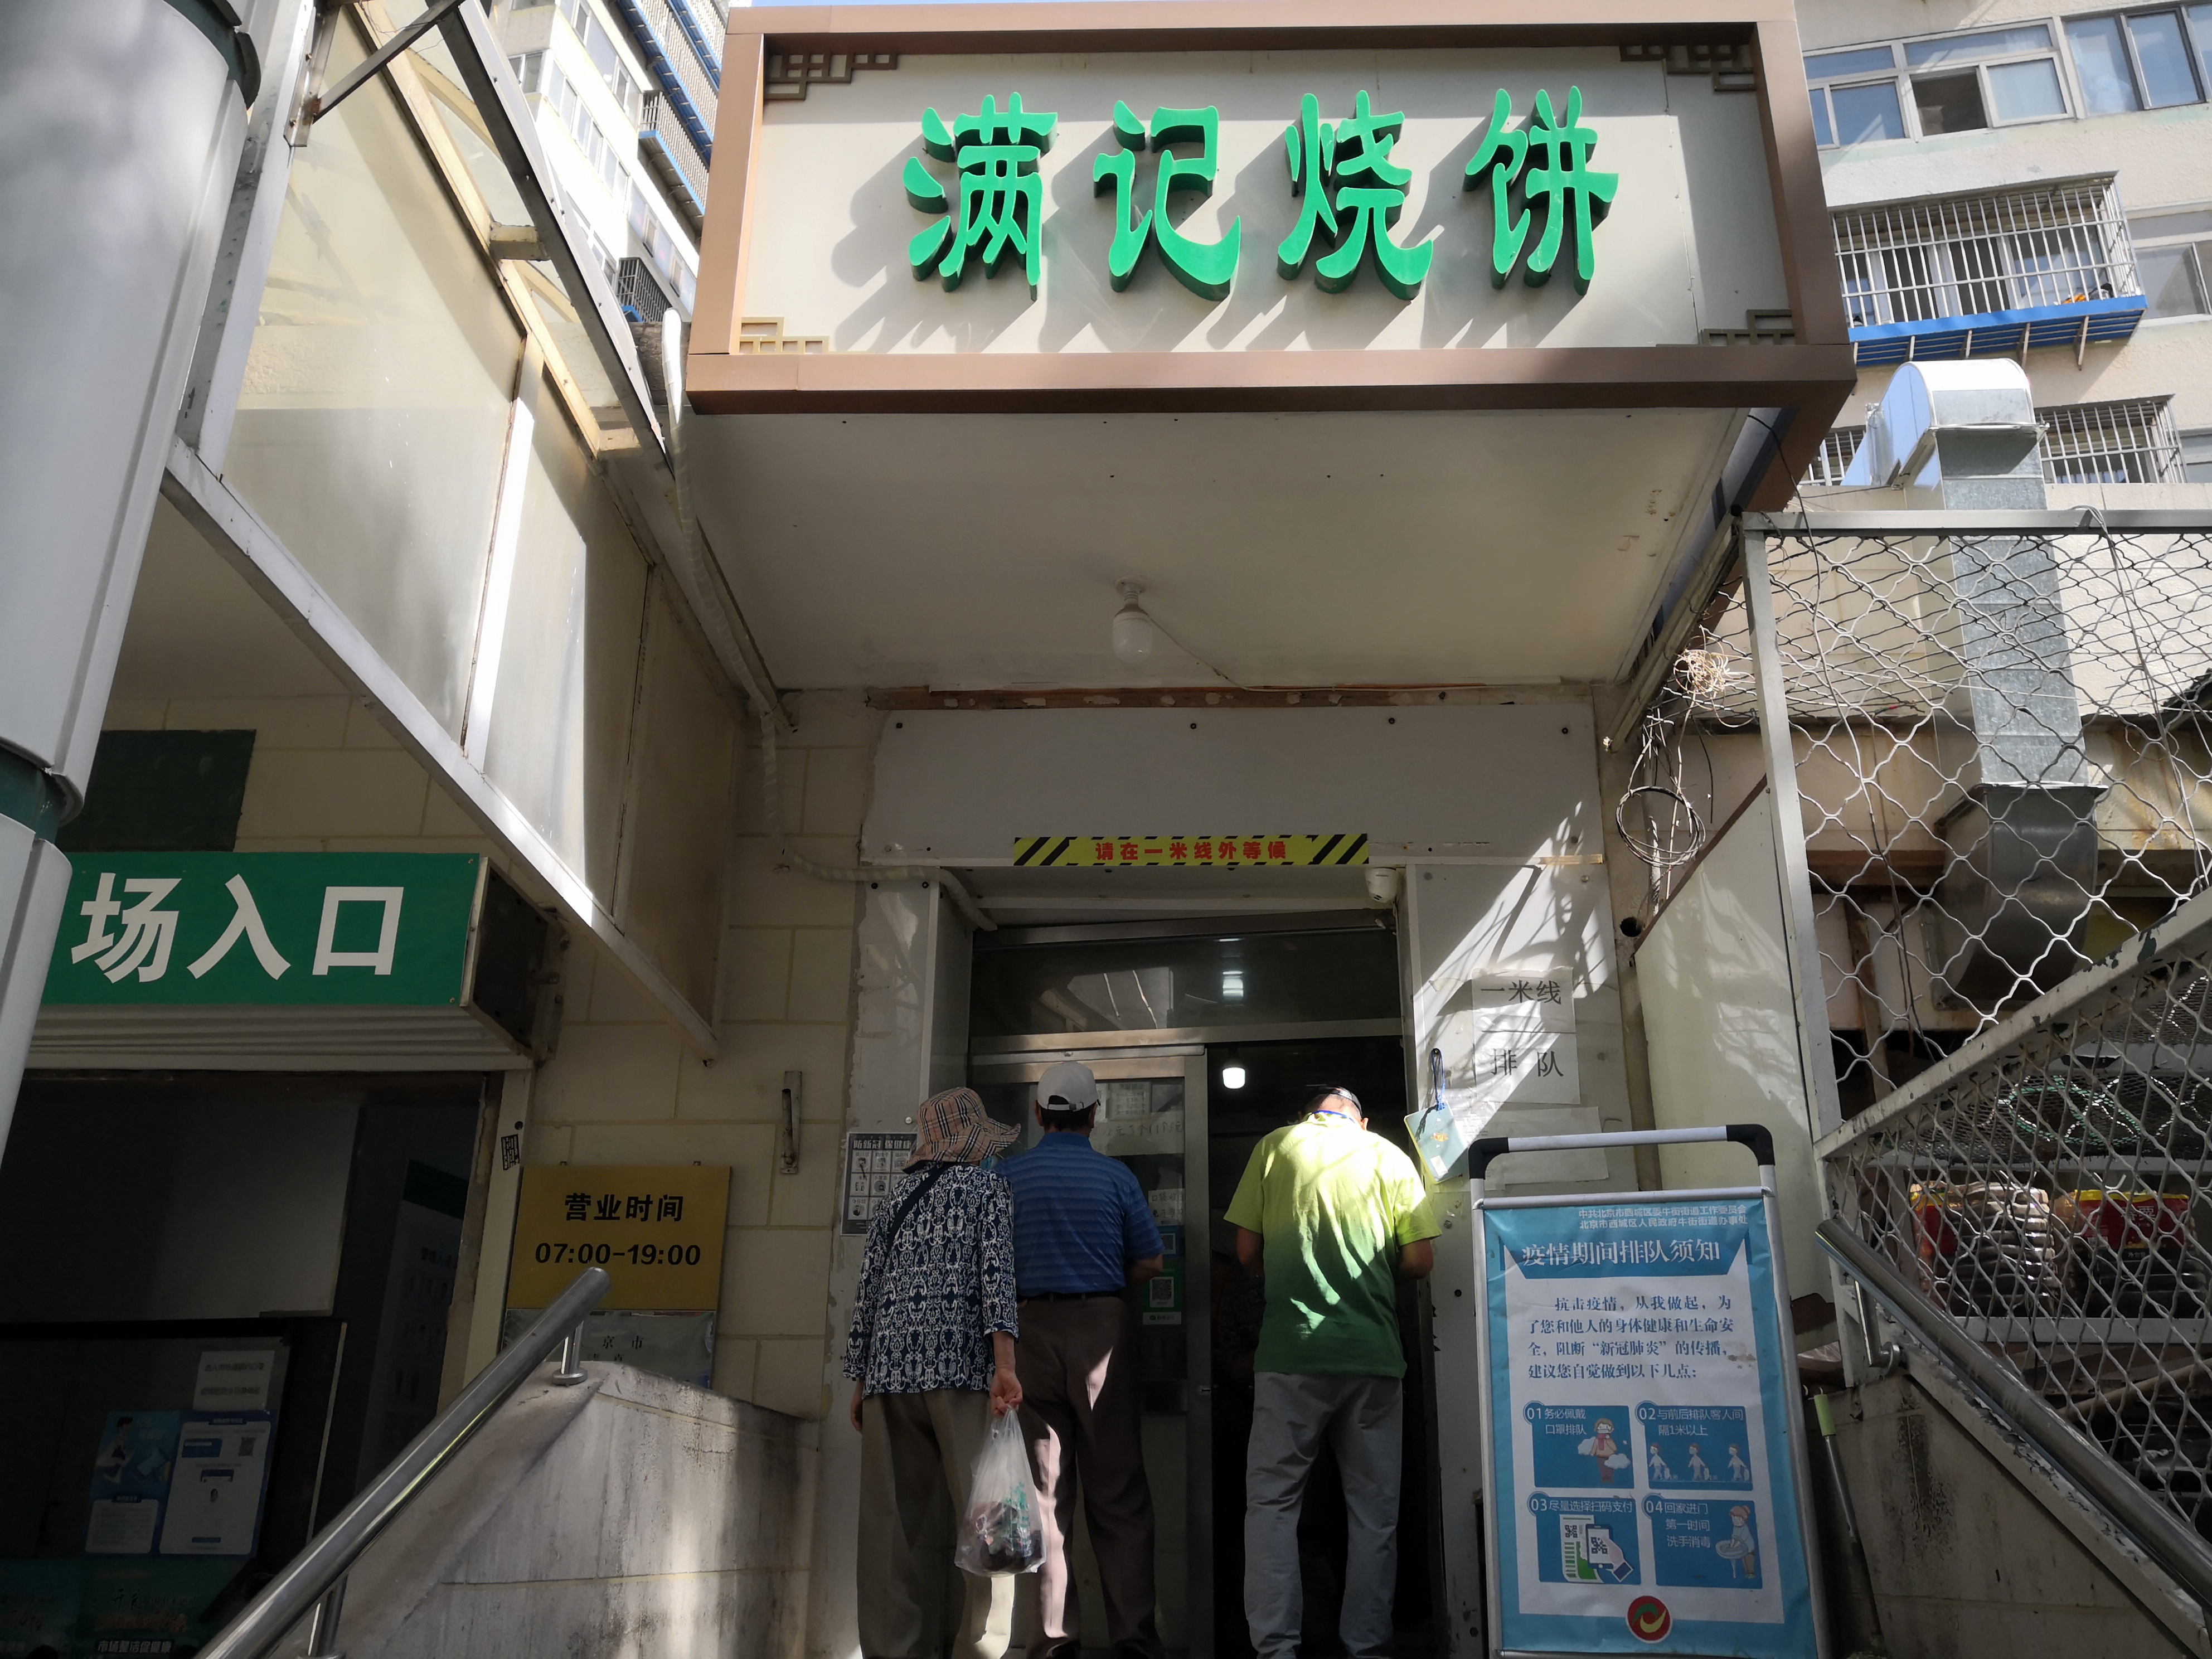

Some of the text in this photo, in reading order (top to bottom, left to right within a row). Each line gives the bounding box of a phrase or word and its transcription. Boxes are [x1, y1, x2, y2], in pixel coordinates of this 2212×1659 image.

[903, 86, 1619, 301] 满记烧饼
[1095, 842, 1286, 860] 请在一米线外等候
[71, 872, 404, 983] 场入口
[1480, 979, 1561, 1005] 一米线
[1490, 1049, 1564, 1077] 排队
[565, 1193, 684, 1222] 营业时间
[1579, 1205, 1747, 1219] 中共北京市西城区委牛街街道工作委员会
[1580, 1216, 1748, 1230] 北京市西城区人民政府牛街街道办事处
[535, 1243, 701, 1265] 07:00-19:00
[1522, 1238, 1720, 1266] 疫情期间排队须知
[1529, 1317, 1734, 1333] 了您和他人的身体健康和生命安
[1527, 1408, 1587, 1420] 01 务必佩戴
[1639, 1408, 1743, 1421] 02 与前后排队客人间
[1546, 1424, 1587, 1435] 口罩排队
[1658, 1424, 1709, 1437] 隔1米以上
[1531, 1500, 1633, 1514] 03 尽量选择扫码支付
[1646, 1500, 1709, 1515] 04 回家进门
[1665, 1519, 1710, 1532] 第一时间
[1667, 1535, 1711, 1548] 洗手消毒
